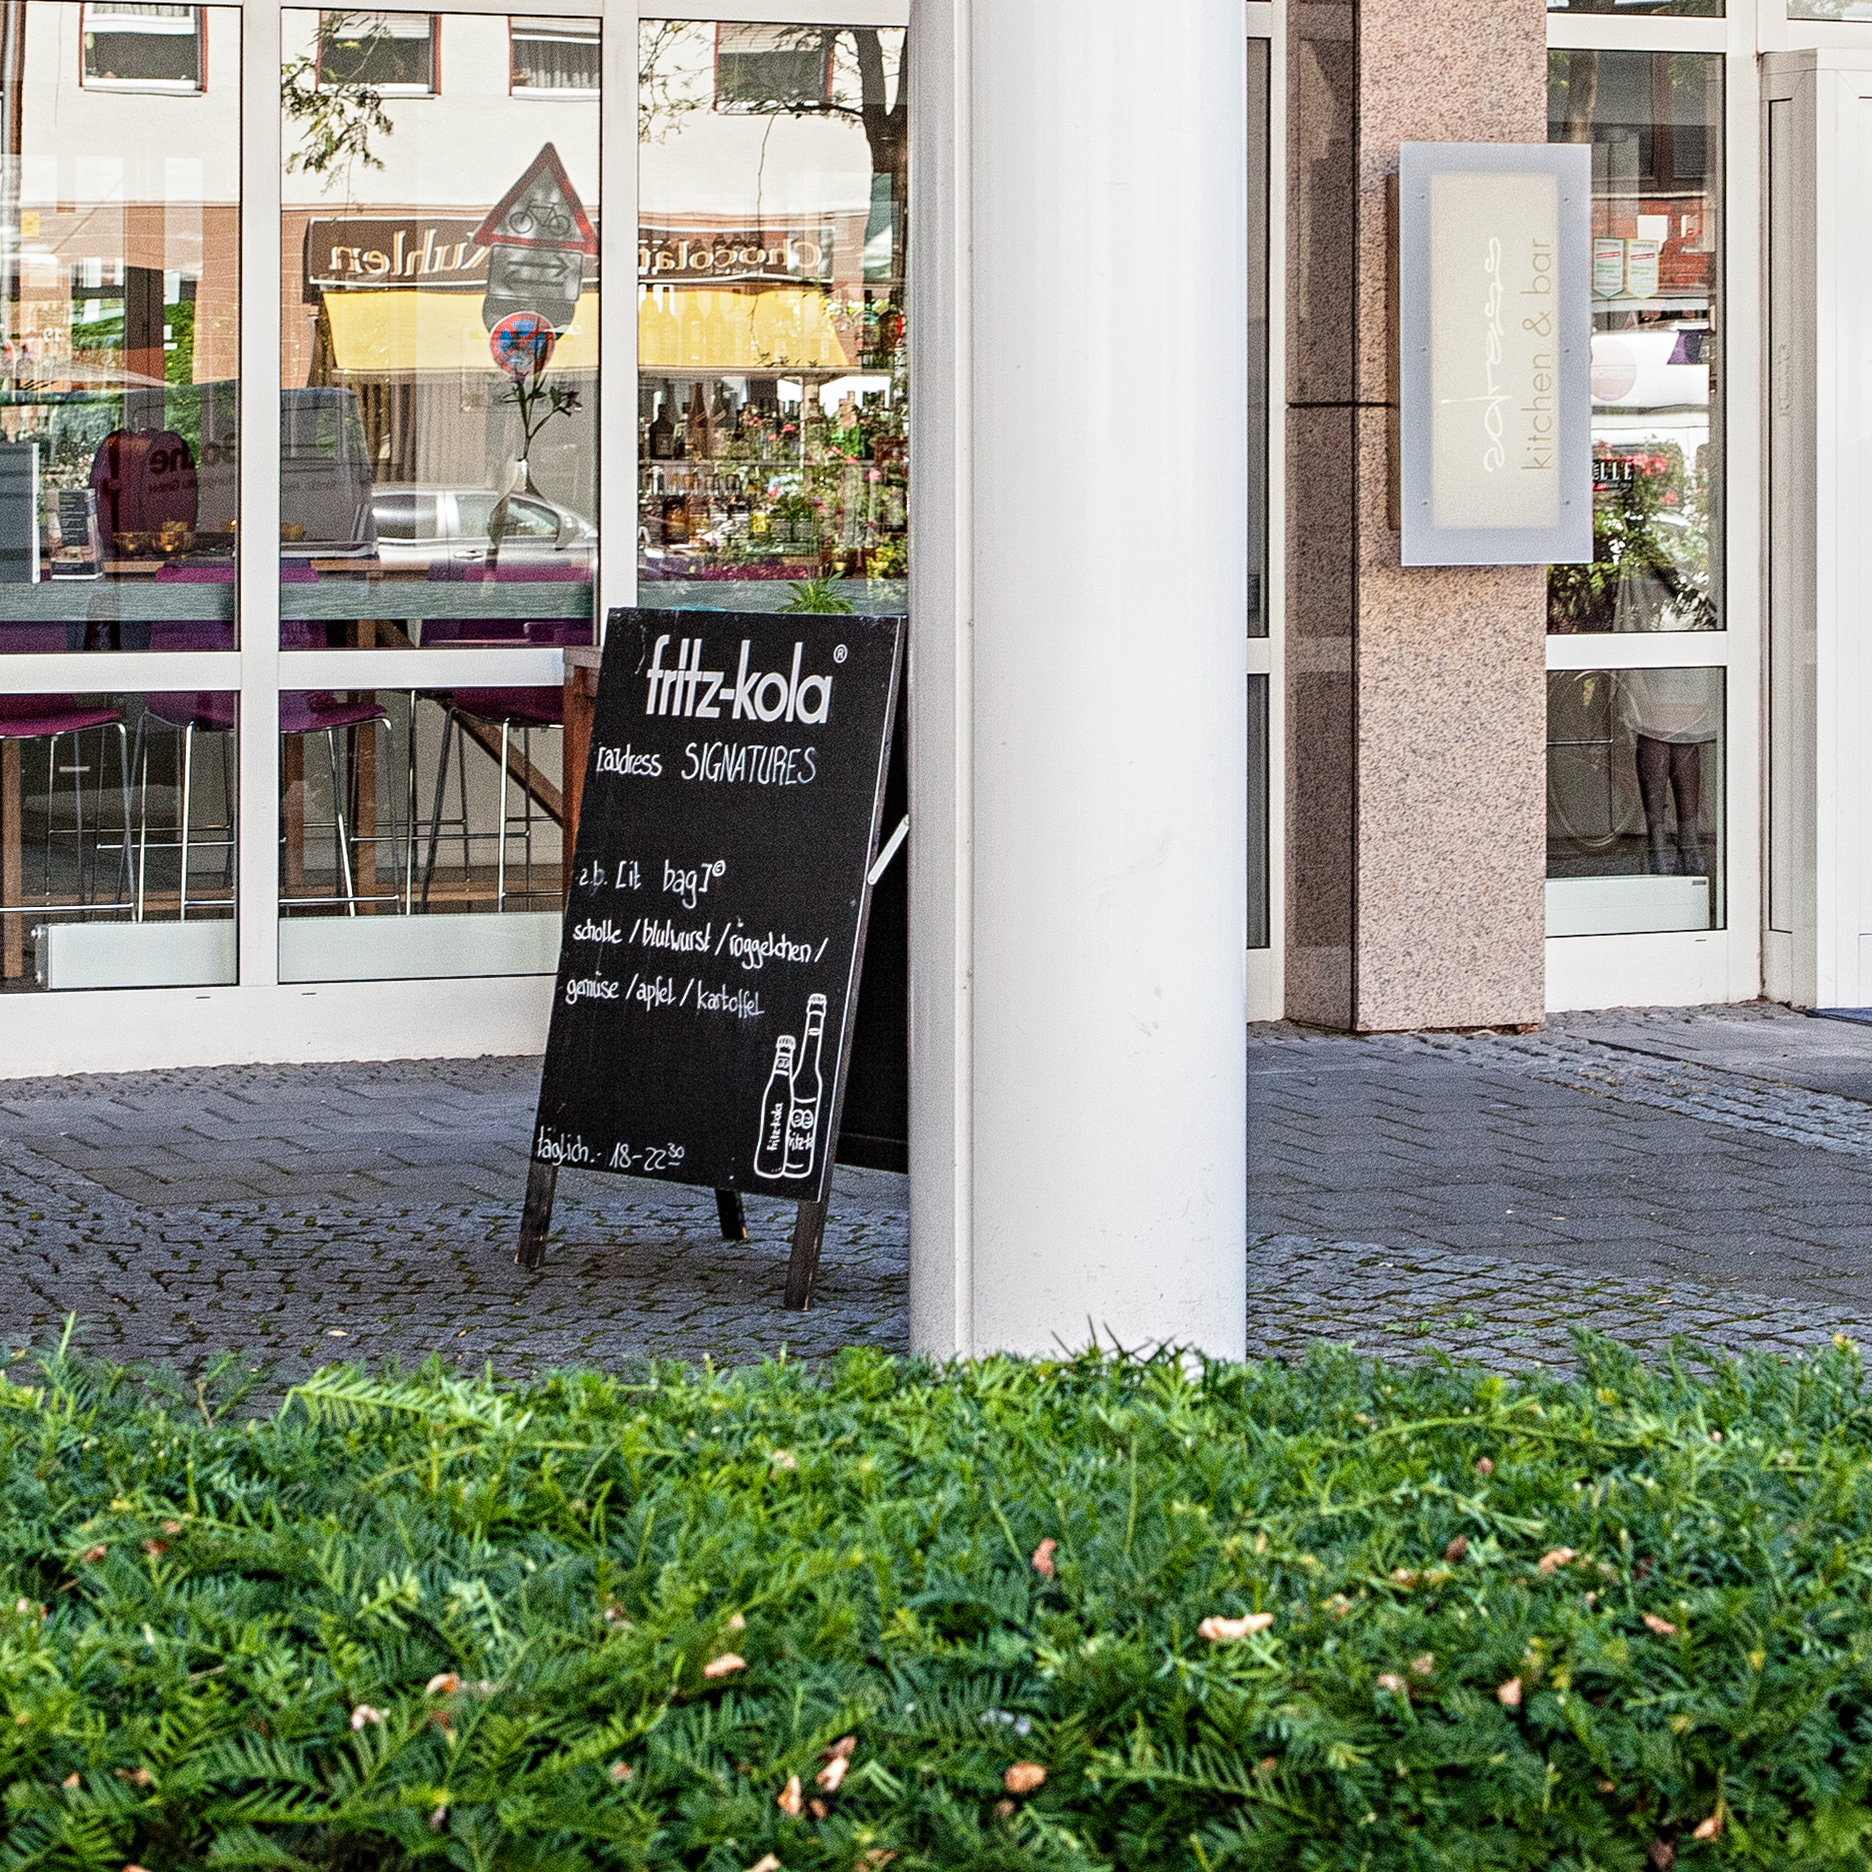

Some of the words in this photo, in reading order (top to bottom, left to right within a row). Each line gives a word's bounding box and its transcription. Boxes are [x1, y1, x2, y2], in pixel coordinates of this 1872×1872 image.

[1520, 238, 1552, 295] bar
[1522, 311, 1552, 337] &
[1520, 353, 1552, 471] kitchen
[681, 741, 818, 786] SIGNATURES
